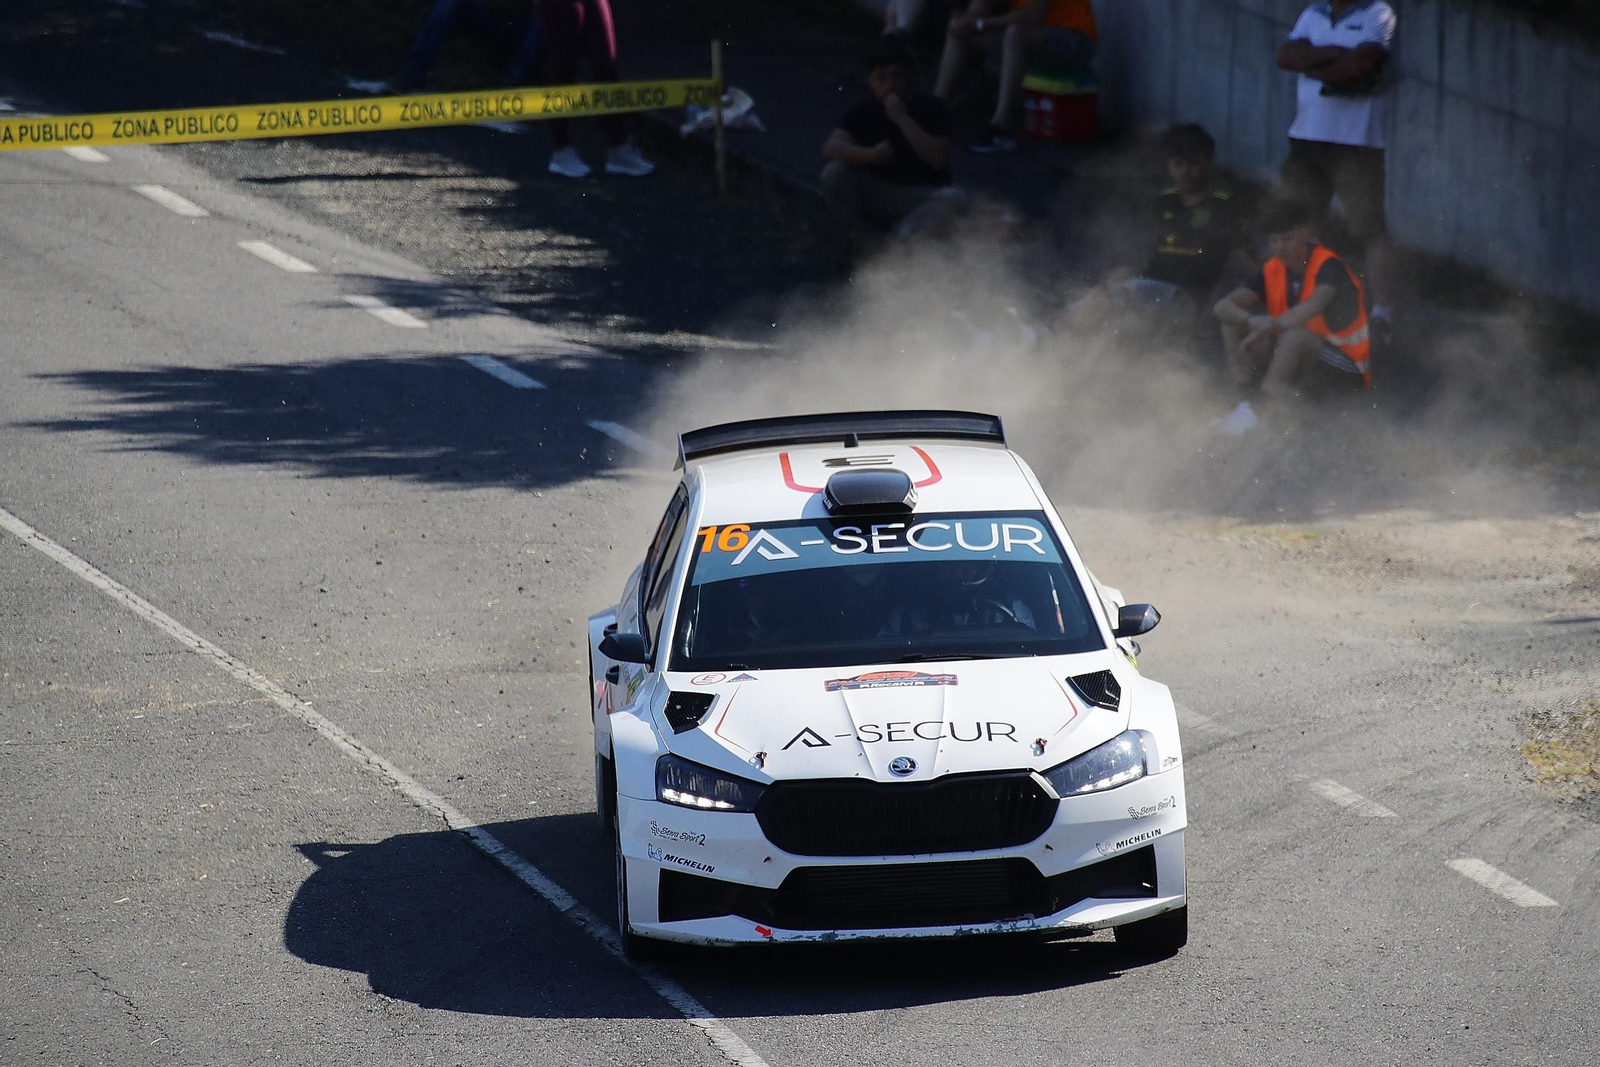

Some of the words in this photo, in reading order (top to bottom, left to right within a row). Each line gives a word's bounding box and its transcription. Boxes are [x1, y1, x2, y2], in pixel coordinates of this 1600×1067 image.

[19, 122, 94, 142] PUBLICO
[112, 119, 160, 139] ZONA
[164, 114, 239, 136] PUBLICO
[256, 110, 302, 131] ZONA
[308, 104, 382, 127] PUBLICO
[400, 102, 447, 122] ZONA
[452, 94, 524, 118] PUBLICO
[542, 93, 590, 112] ZONA
[593, 86, 667, 110] PUBLICO
[699, 523, 752, 554] 16
[731, 522, 1046, 566] A-SECUR
[781, 721, 1018, 750] A-SECUR
[699, 834, 705, 846] 2
[1116, 829, 1161, 849] MICHELIN
[664, 854, 715, 872] MICHELIN
